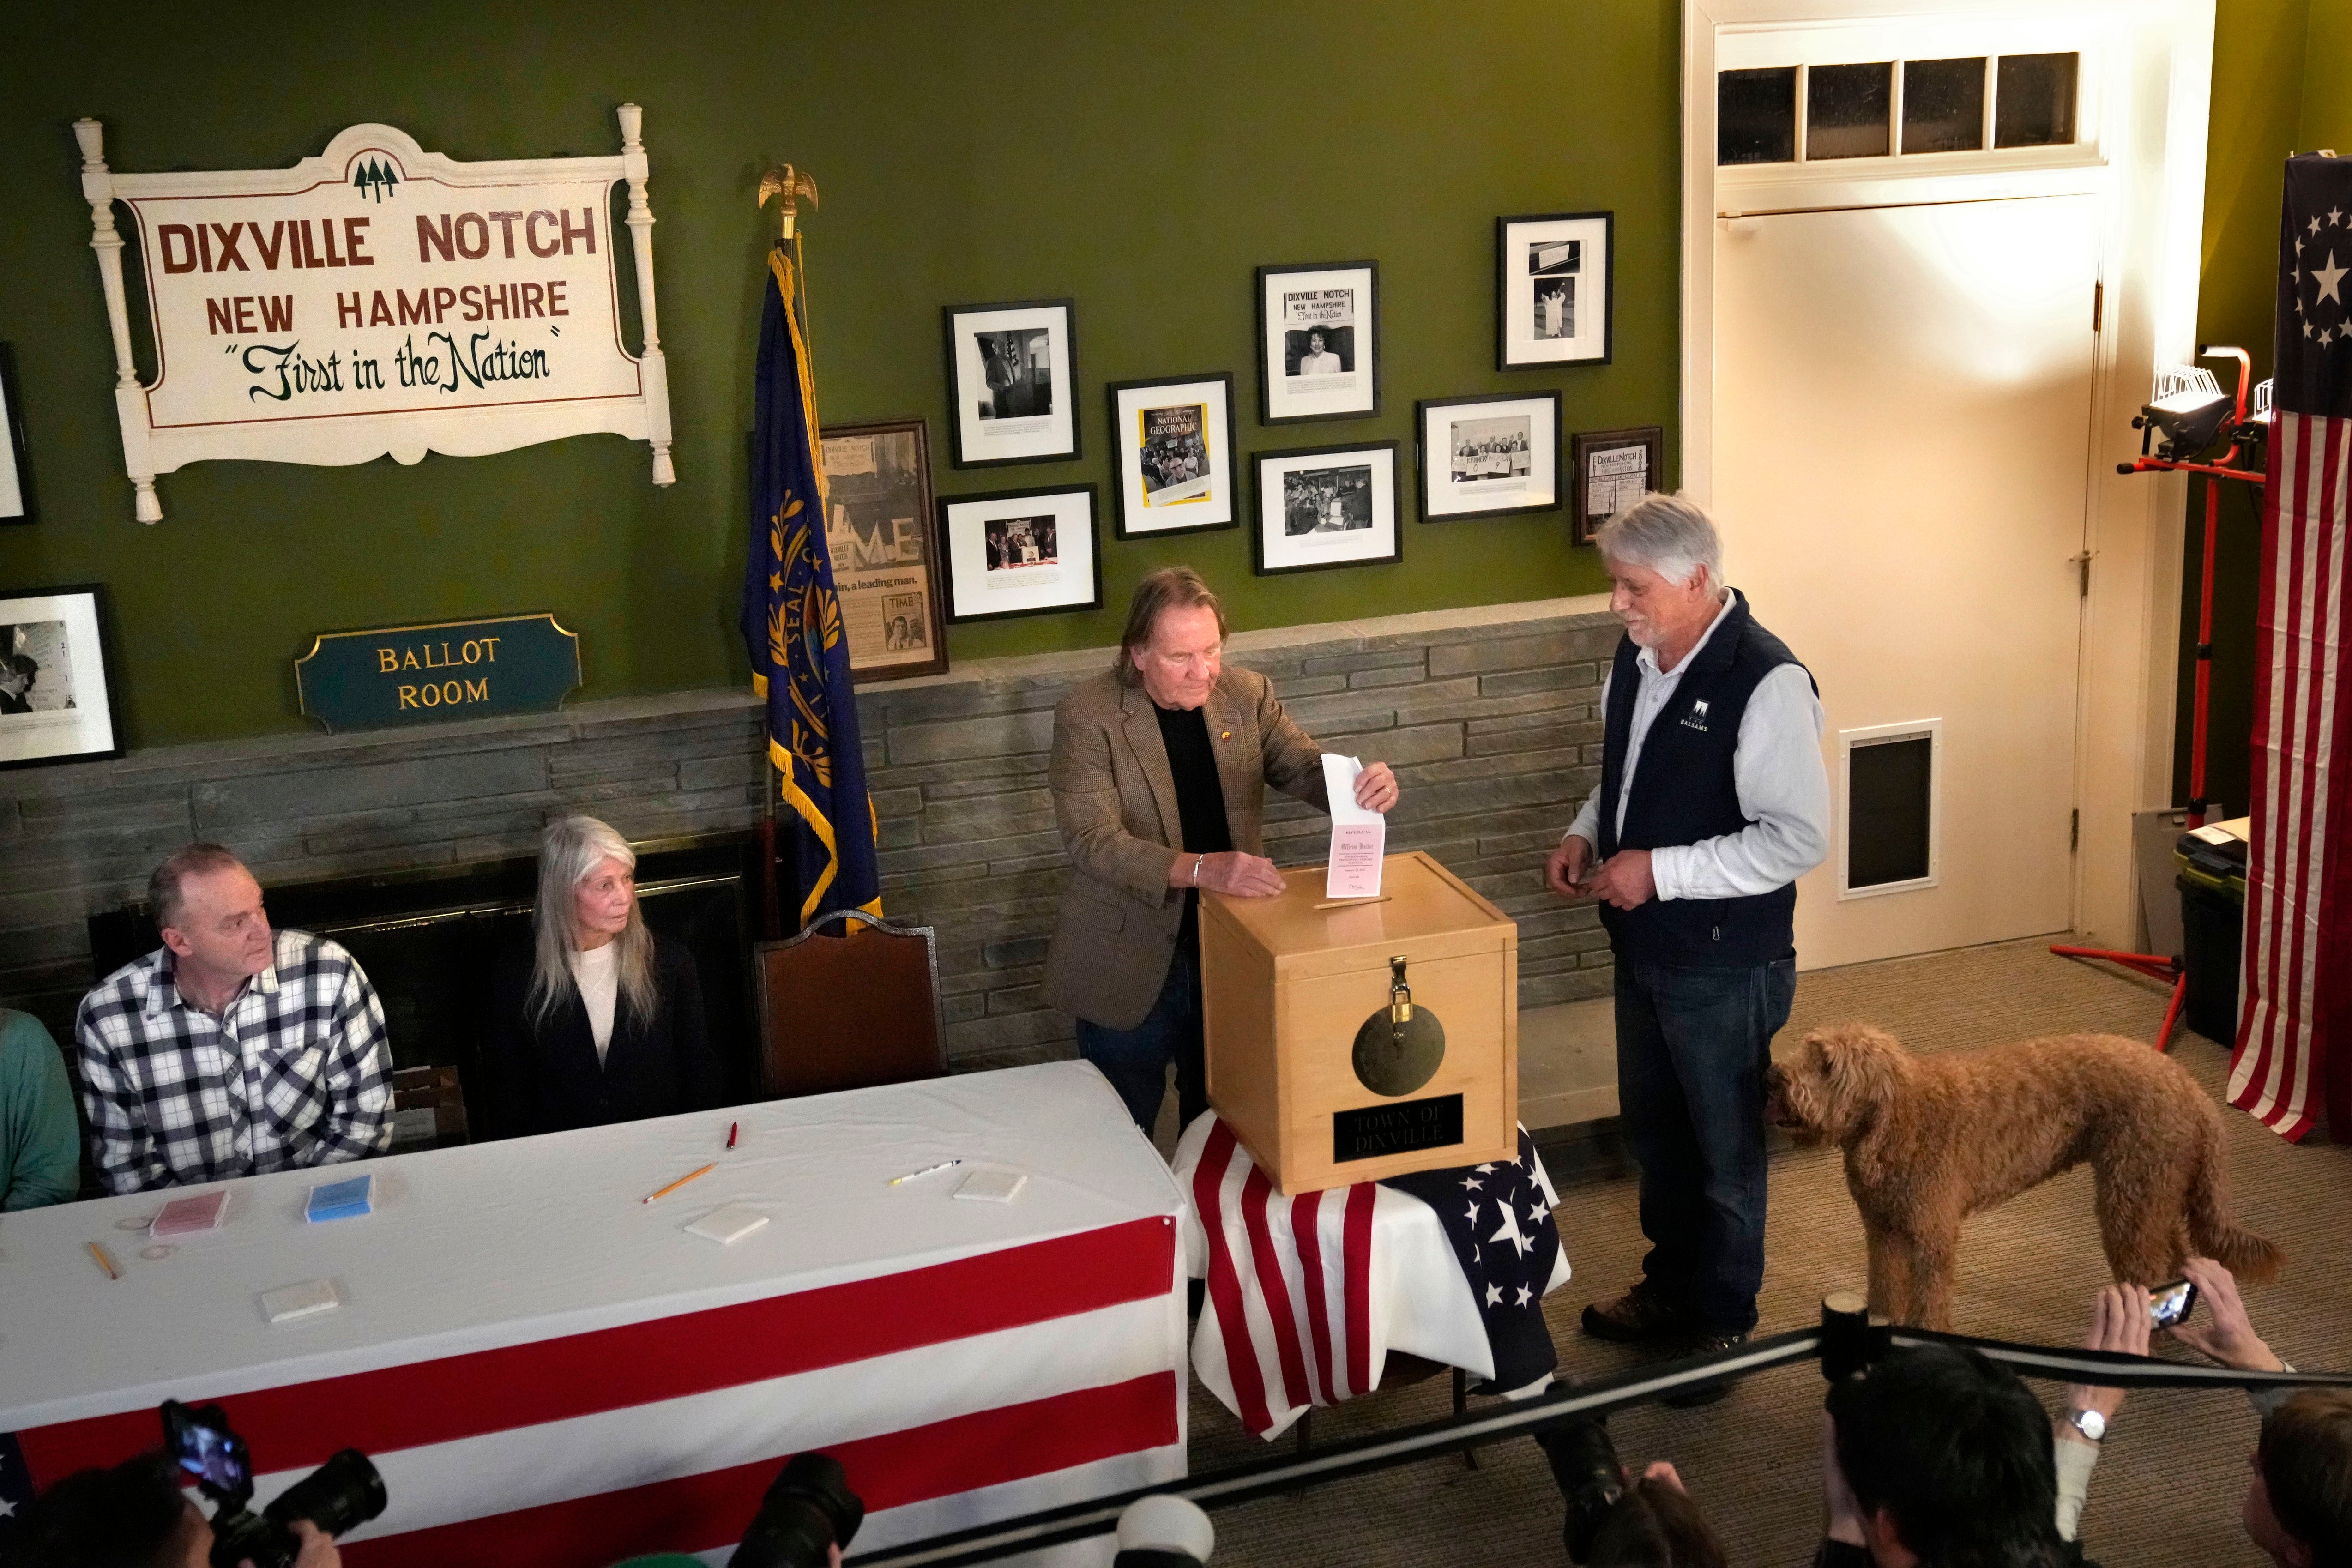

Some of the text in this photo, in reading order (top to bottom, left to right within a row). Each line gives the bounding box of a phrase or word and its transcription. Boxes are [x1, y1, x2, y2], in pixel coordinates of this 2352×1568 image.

[158, 207, 597, 274] DIXVILLE NOTCH
[1288, 289, 1350, 301] DIXVILLE NOTCH
[206, 281, 570, 335] NEW HAMPSHIRE
[1311, 301, 1345, 309] HAMPSHIRE
[225, 325, 561, 403] "First in the Nation"
[1157, 415, 1191, 424] NATIONAL
[1150, 422, 1197, 434] GEOGRAPHIC
[1467, 455, 1488, 464] KENNEDY
[1619, 452, 1636, 461] NOTCH
[1495, 461, 1500, 471] 9
[857, 578, 893, 589] leading
[893, 577, 917, 585] man.
[890, 596, 914, 608] TIME
[786, 585, 804, 644] SEAL
[377, 638, 500, 673] BALLOT
[398, 677, 489, 710] ROOM
[1680, 719, 1708, 732] BALSAMS
[1354, 1104, 1444, 1132] TOWN OF
[1355, 1124, 1444, 1153] DIXVILLE
